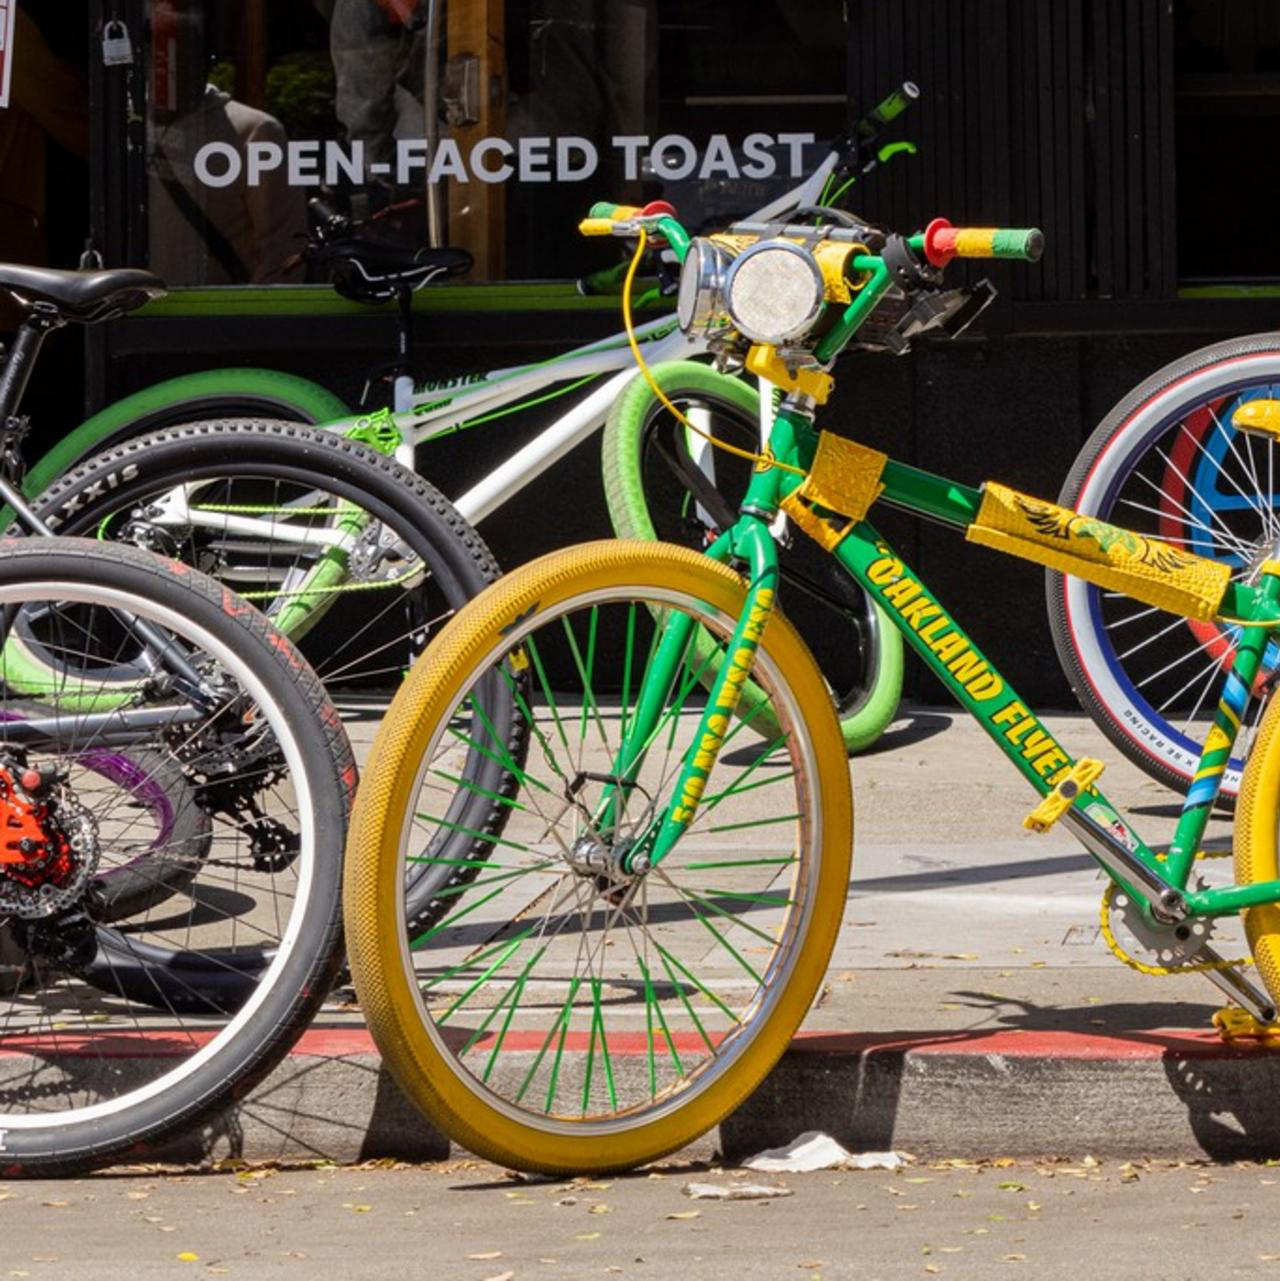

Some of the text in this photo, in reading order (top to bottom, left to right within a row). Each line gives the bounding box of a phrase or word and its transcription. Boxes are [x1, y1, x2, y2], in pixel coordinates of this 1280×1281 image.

[193, 132, 816, 190] OPEN-FACED TOAST
[1123, 709, 1165, 749] RACING
